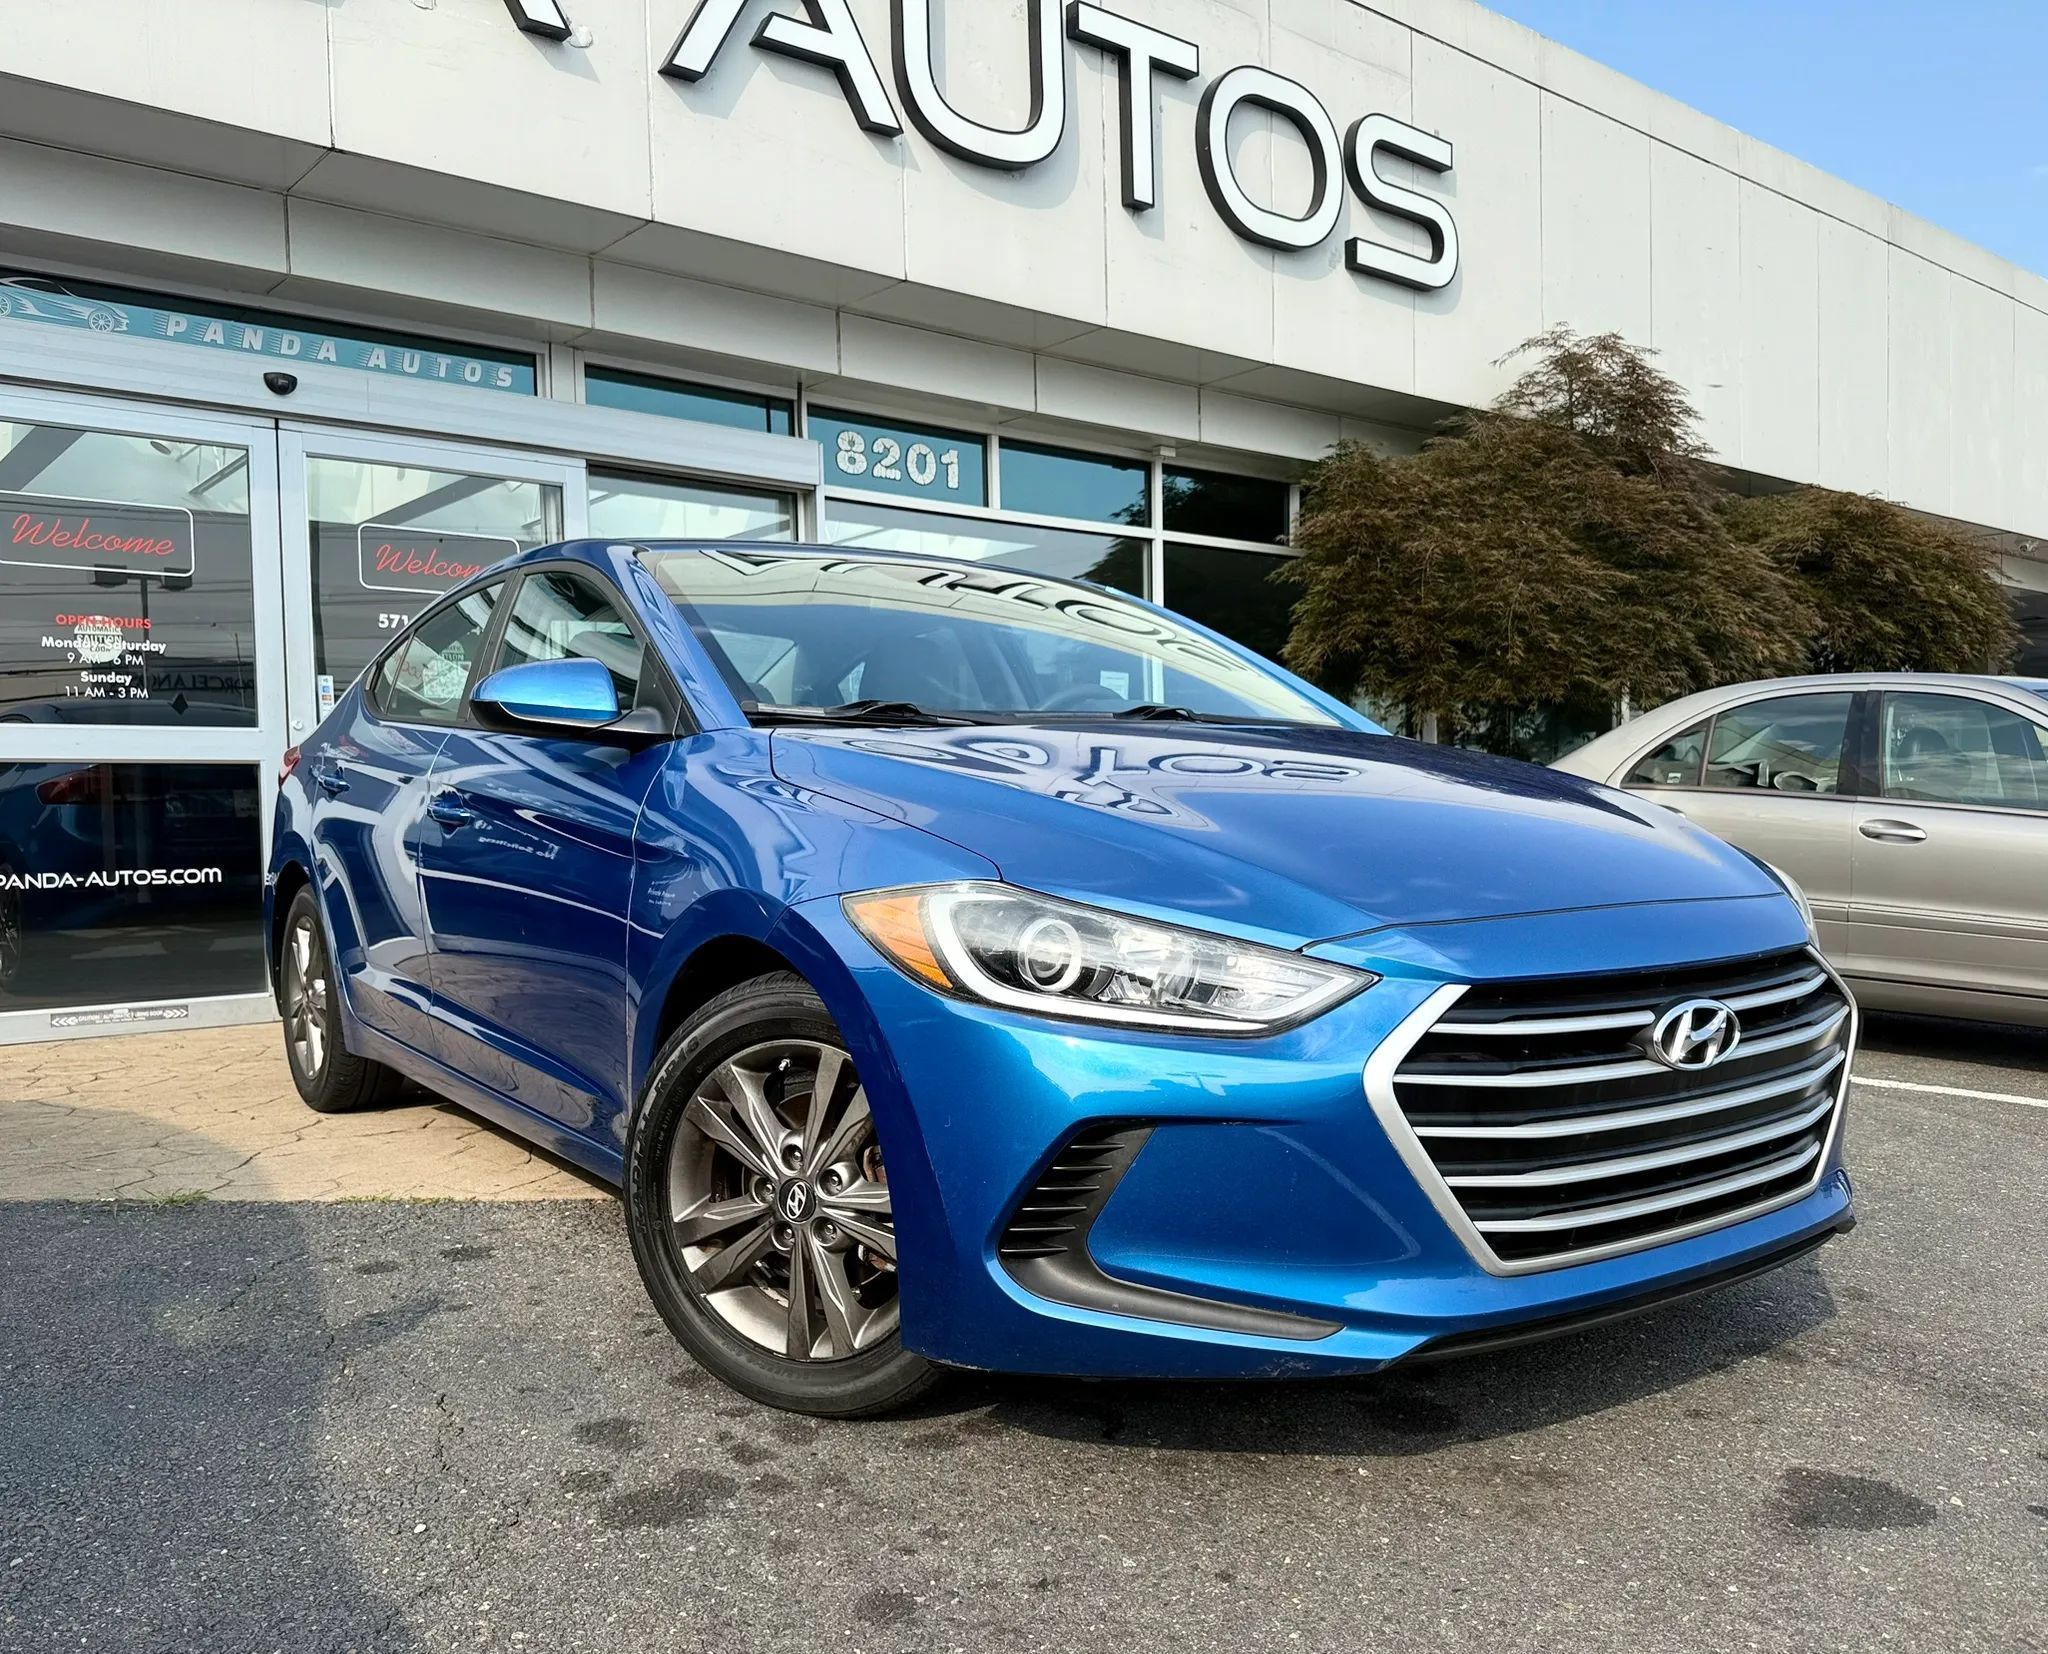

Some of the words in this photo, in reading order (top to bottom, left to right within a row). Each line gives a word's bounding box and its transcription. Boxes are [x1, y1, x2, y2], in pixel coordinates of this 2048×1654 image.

[658, 0, 1459, 292] AUTOS
[164, 313, 338, 362] PANDA
[366, 347, 513, 388] AUTOS
[836, 431, 960, 490] 8201
[11, 513, 176, 556] Welcome
[376, 544, 481, 578] Welco
[55, 614, 98, 625] OPEN
[101, 616, 152, 629] HOURS
[378, 612, 409, 629] 571
[67, 652, 76, 664] 9
[113, 654, 122, 665] 6
[125, 654, 144, 665] PM
[80, 671, 132, 686] Sunday
[65, 686, 79, 697] 11
[85, 687, 106, 698] AM
[118, 688, 127, 698] 3
[130, 688, 149, 699] PM
